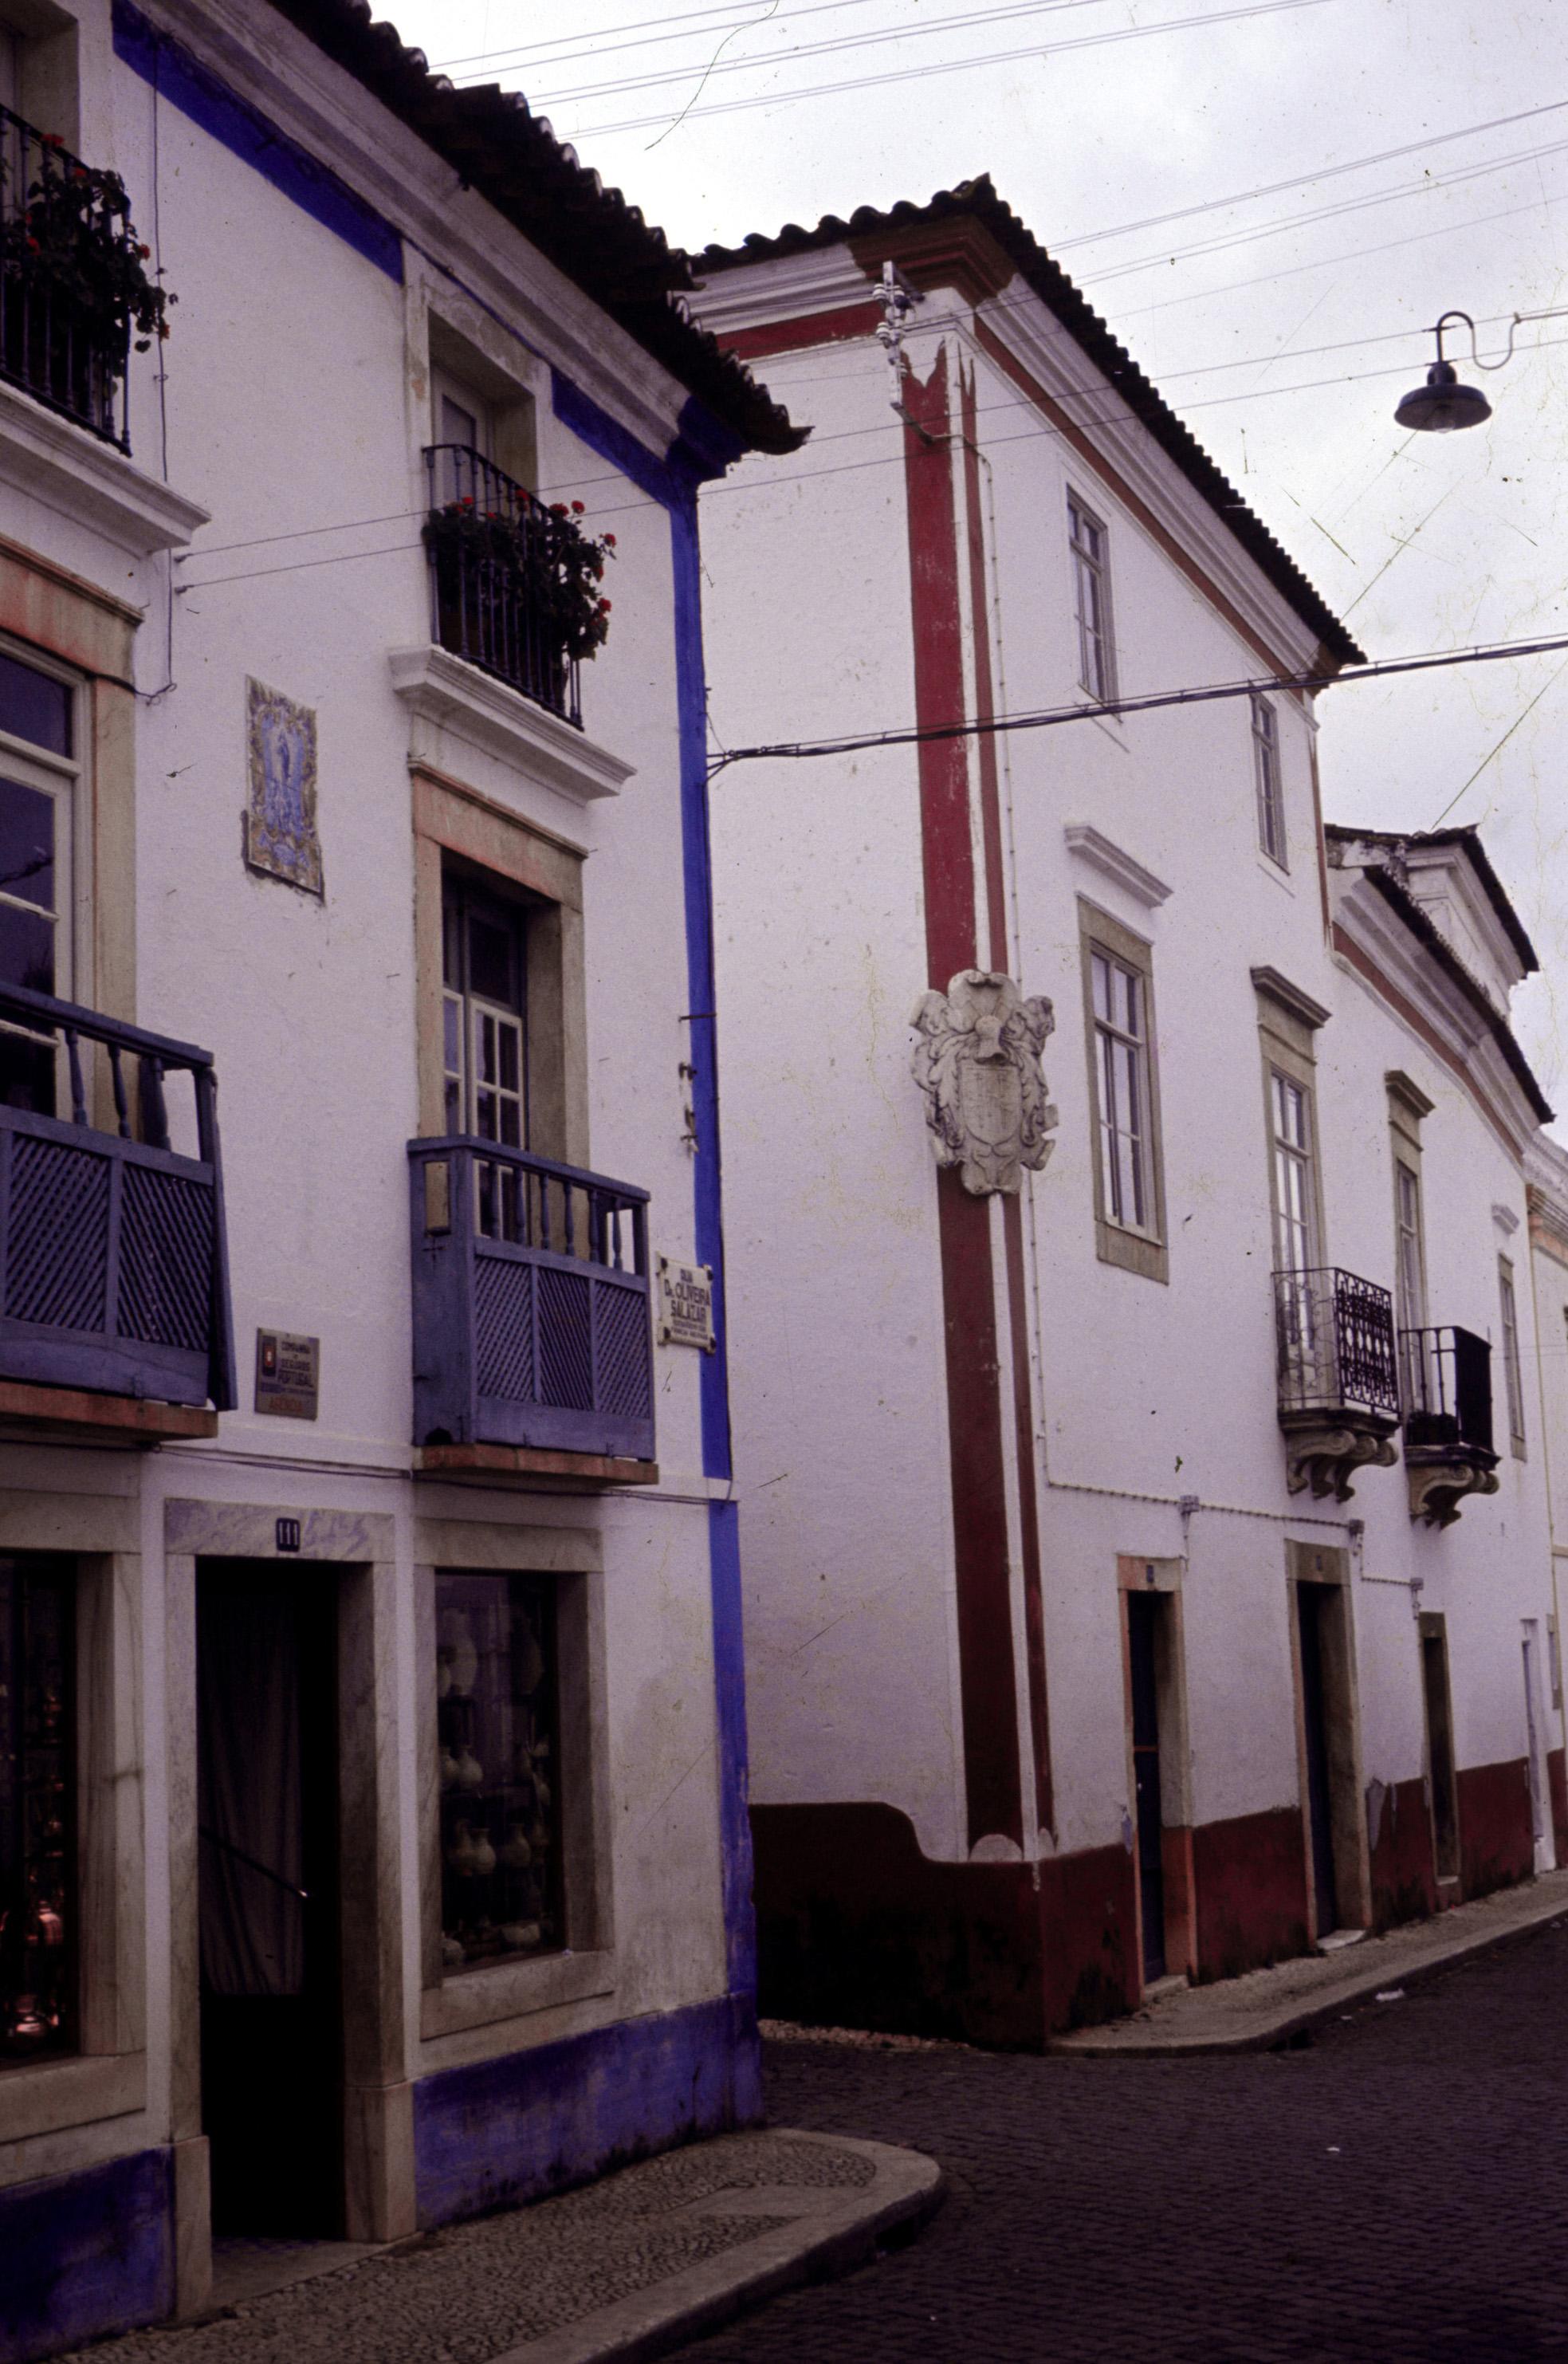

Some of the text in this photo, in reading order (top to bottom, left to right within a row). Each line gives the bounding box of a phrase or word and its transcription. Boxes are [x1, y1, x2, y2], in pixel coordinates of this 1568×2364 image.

[675, 1282, 710, 1306] OLIVEIRA
[671, 1300, 706, 1323] SALAZAR
[278, 1521, 298, 1546] 111
